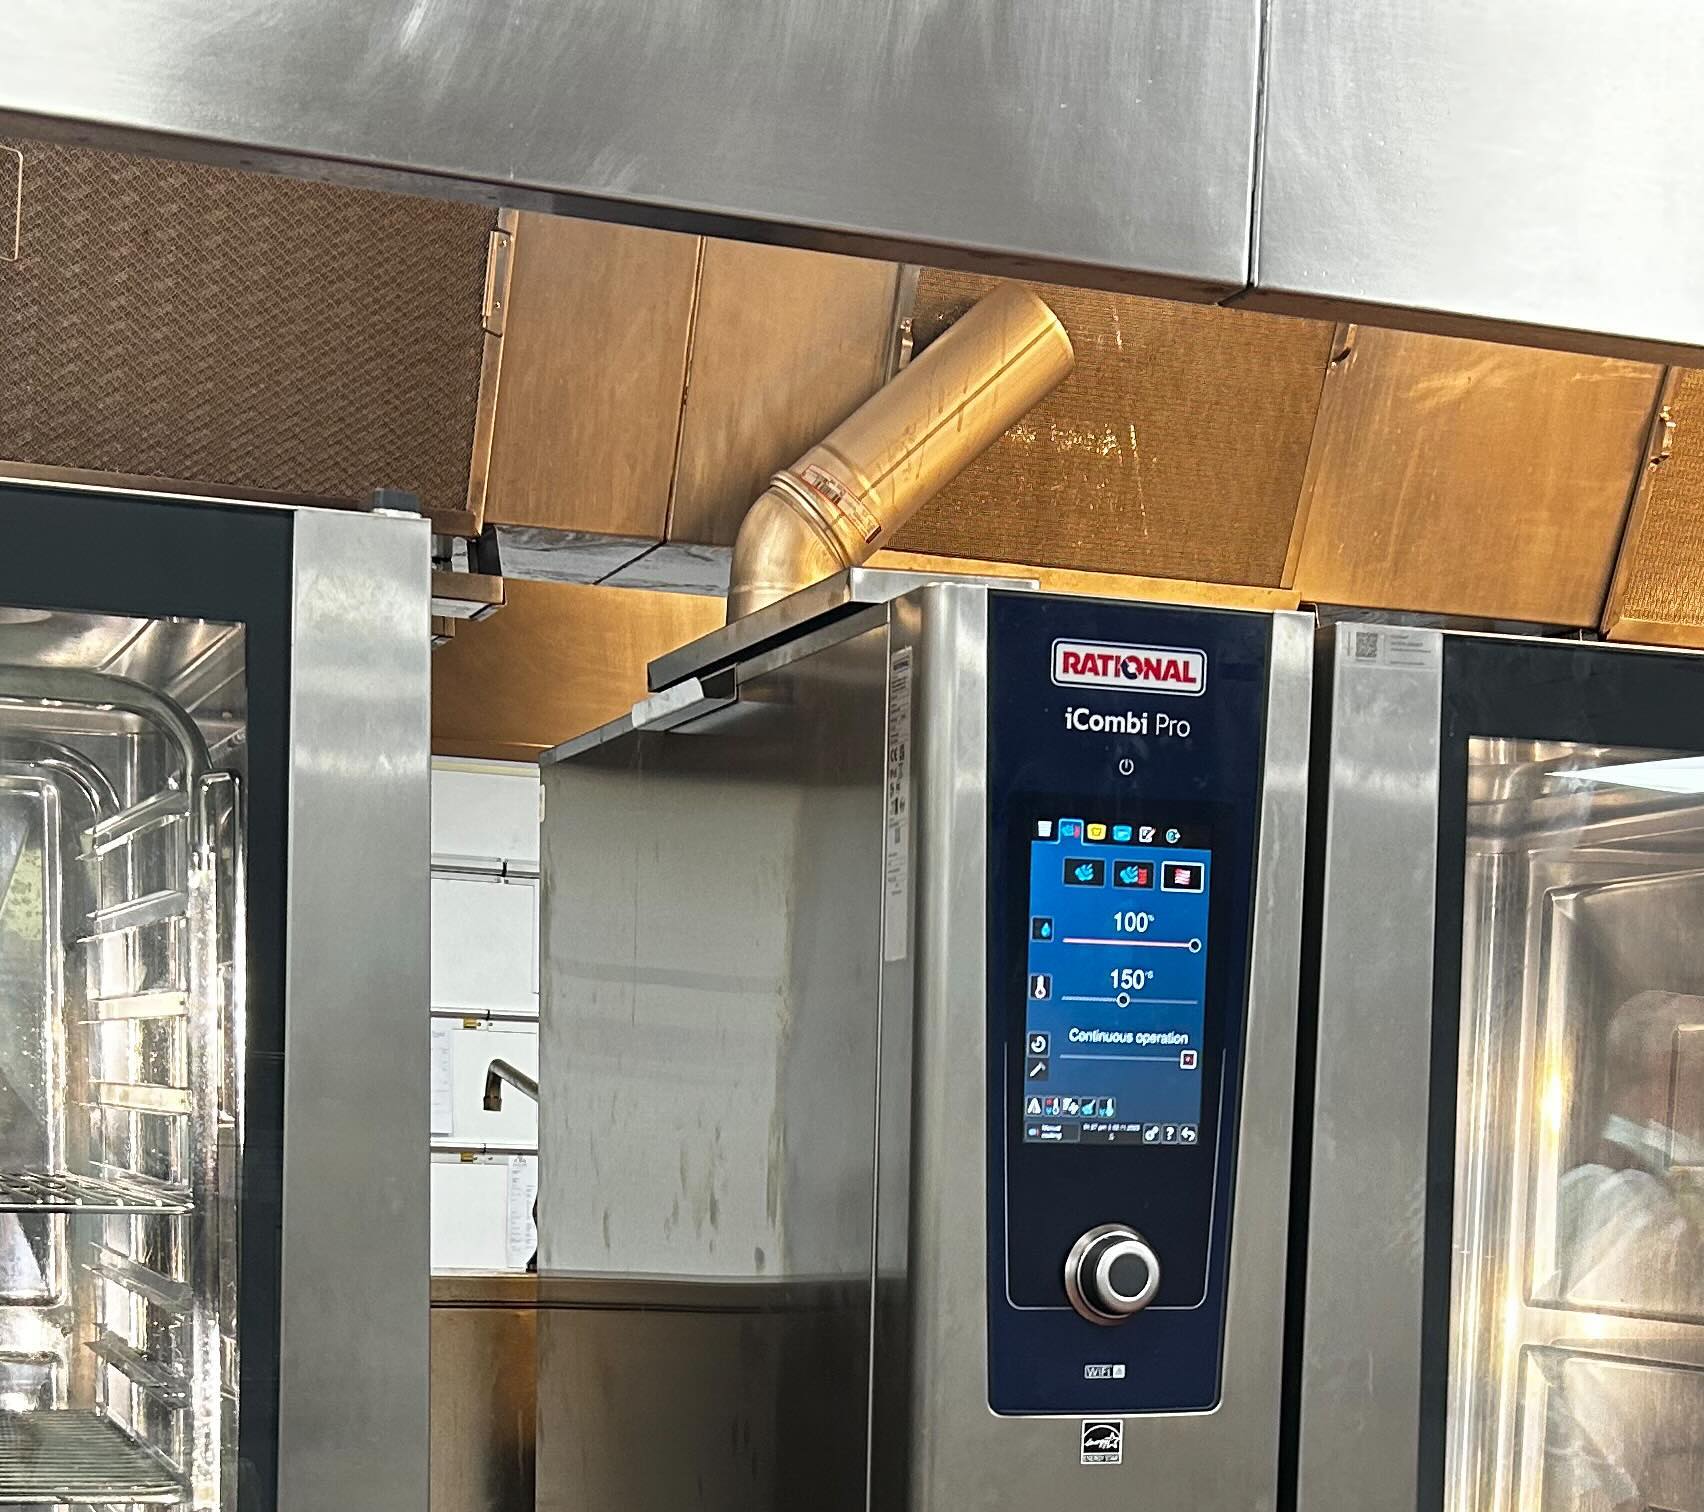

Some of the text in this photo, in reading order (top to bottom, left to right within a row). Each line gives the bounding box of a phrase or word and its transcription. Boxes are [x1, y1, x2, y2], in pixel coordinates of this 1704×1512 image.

[1062, 650, 1197, 684] RATIONAL
[1065, 706, 1191, 738] iCombi Pro
[1068, 1027, 1189, 1047] Continuous operation
